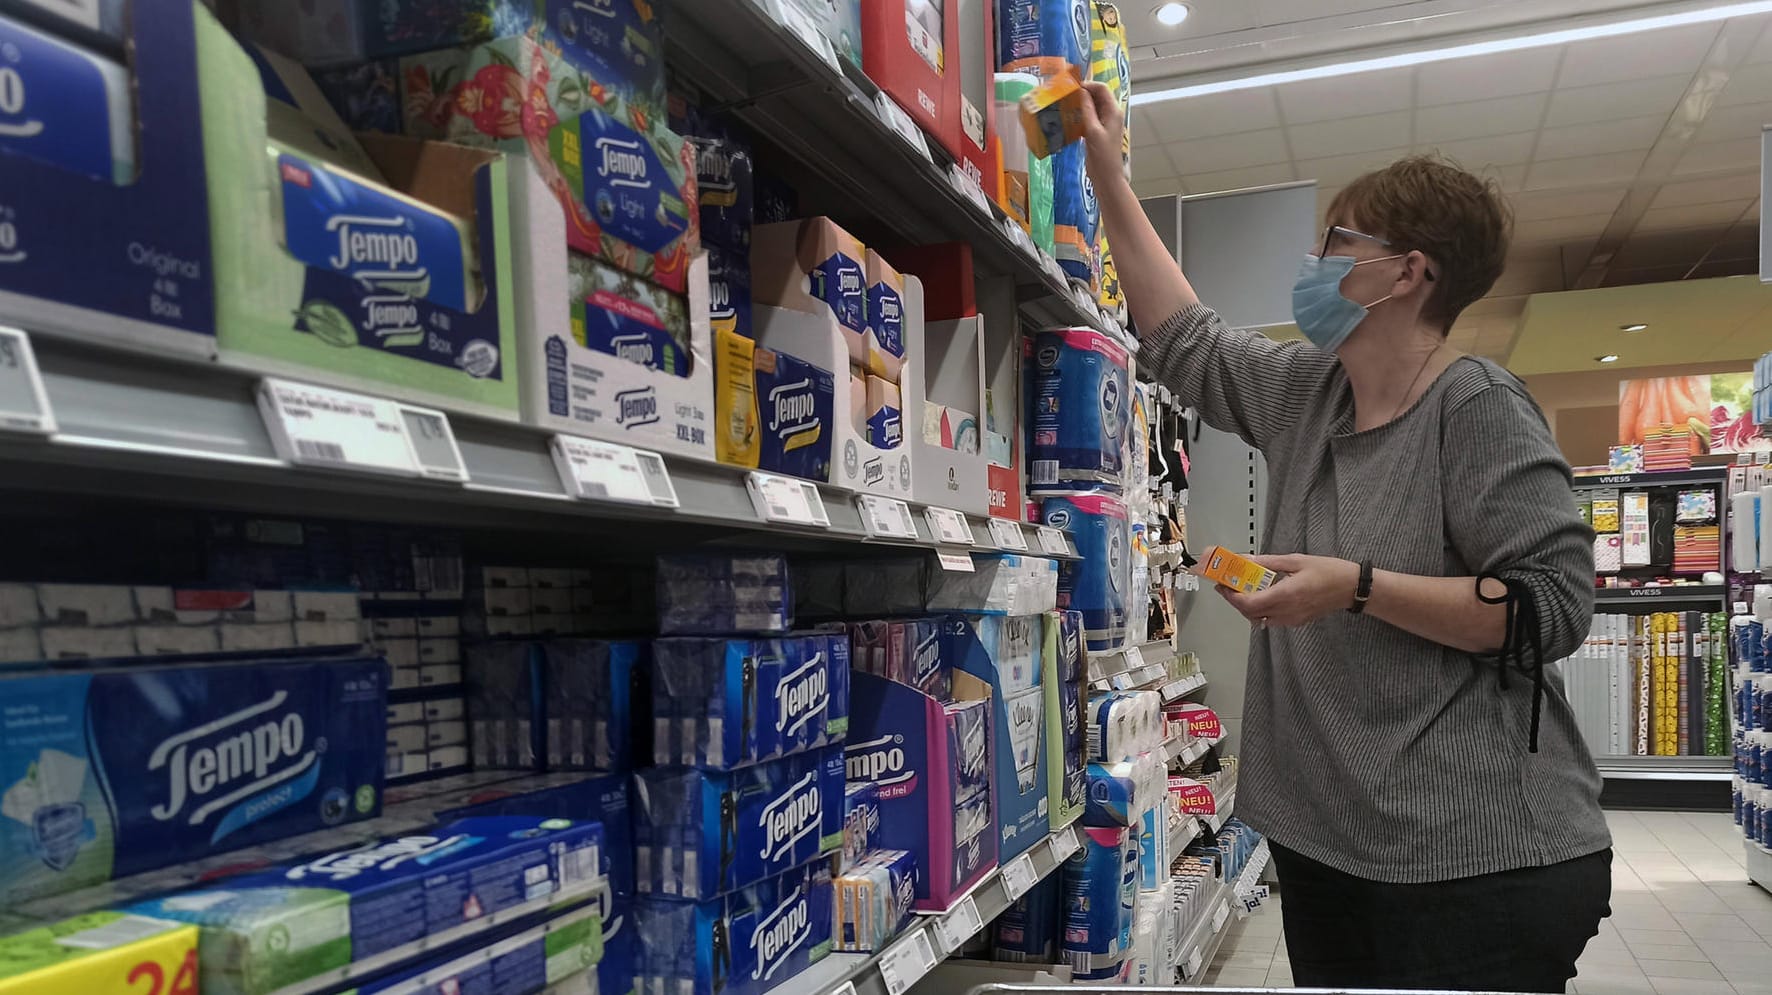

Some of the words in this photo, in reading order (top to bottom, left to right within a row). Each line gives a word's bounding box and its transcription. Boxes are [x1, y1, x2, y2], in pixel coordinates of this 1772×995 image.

[595, 137, 646, 180] Tempo
[963, 155, 982, 185] REWE
[620, 192, 645, 219] Light
[127, 242, 200, 279] Original
[326, 215, 417, 270] Tempo
[837, 267, 860, 292] Tempo
[361, 295, 418, 331] Tempo
[880, 296, 899, 319] Tempo
[614, 386, 657, 424] Tempo
[769, 377, 814, 431] Tempo
[863, 456, 883, 484] Tempo
[1600, 475, 1631, 484] VIVESS
[1630, 588, 1662, 597] VIVESS
[914, 630, 939, 685] Tempo
[776, 652, 827, 732] Tempo
[1190, 720, 1218, 731] NEU!
[148, 690, 304, 821] Tempo
[760, 772, 819, 860] Tempo
[1181, 796, 1211, 808] NEU!
[1243, 897, 1261, 912] ja!
[750, 885, 808, 980] Tempo
